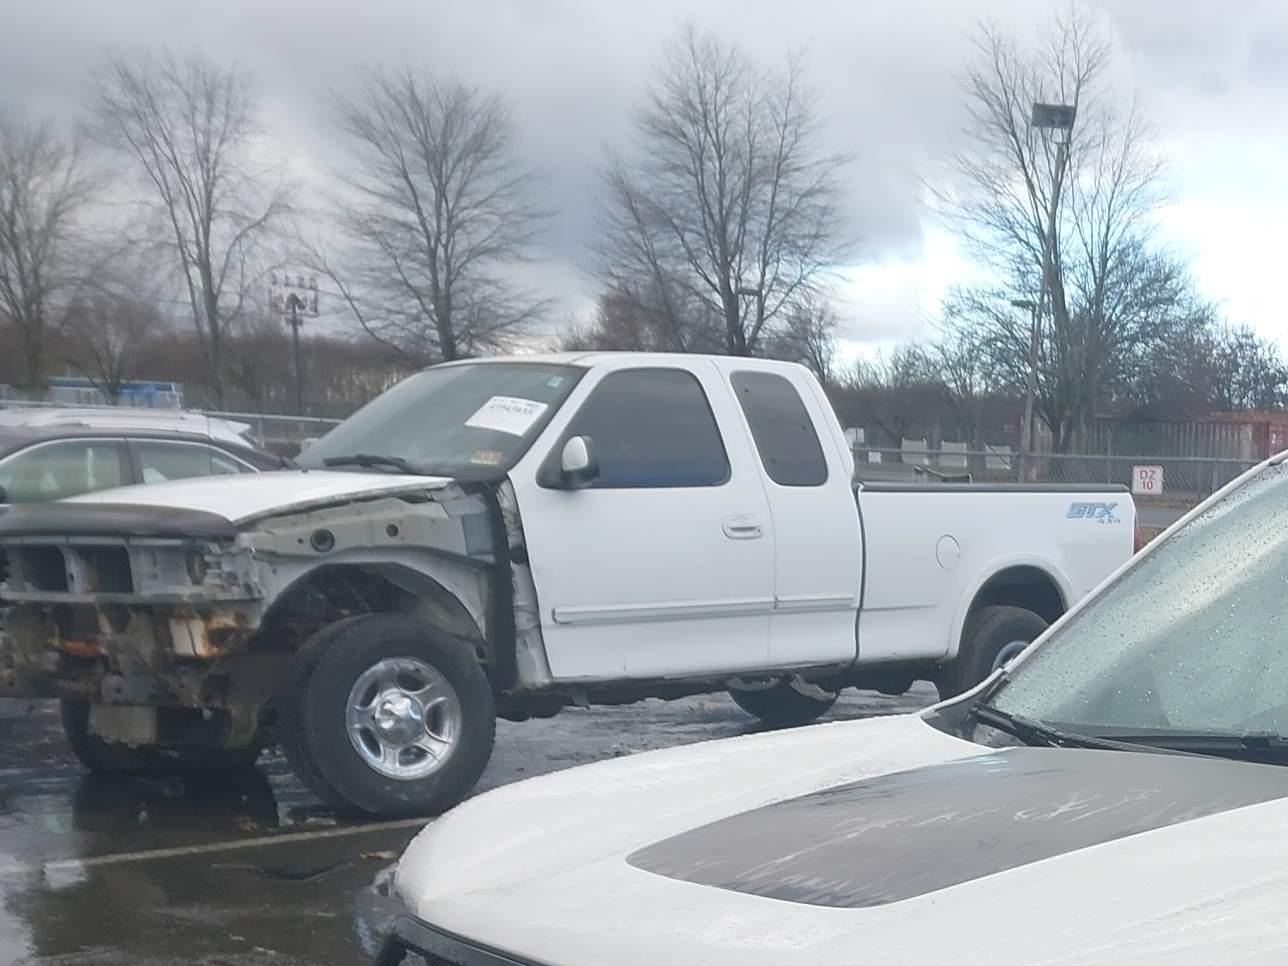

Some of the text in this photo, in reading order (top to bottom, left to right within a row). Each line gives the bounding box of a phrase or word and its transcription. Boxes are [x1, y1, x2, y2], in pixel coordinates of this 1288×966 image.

[1139, 469, 1156, 480] DZ
[1142, 481, 1153, 490] 10
[1066, 502, 1119, 519] STX
